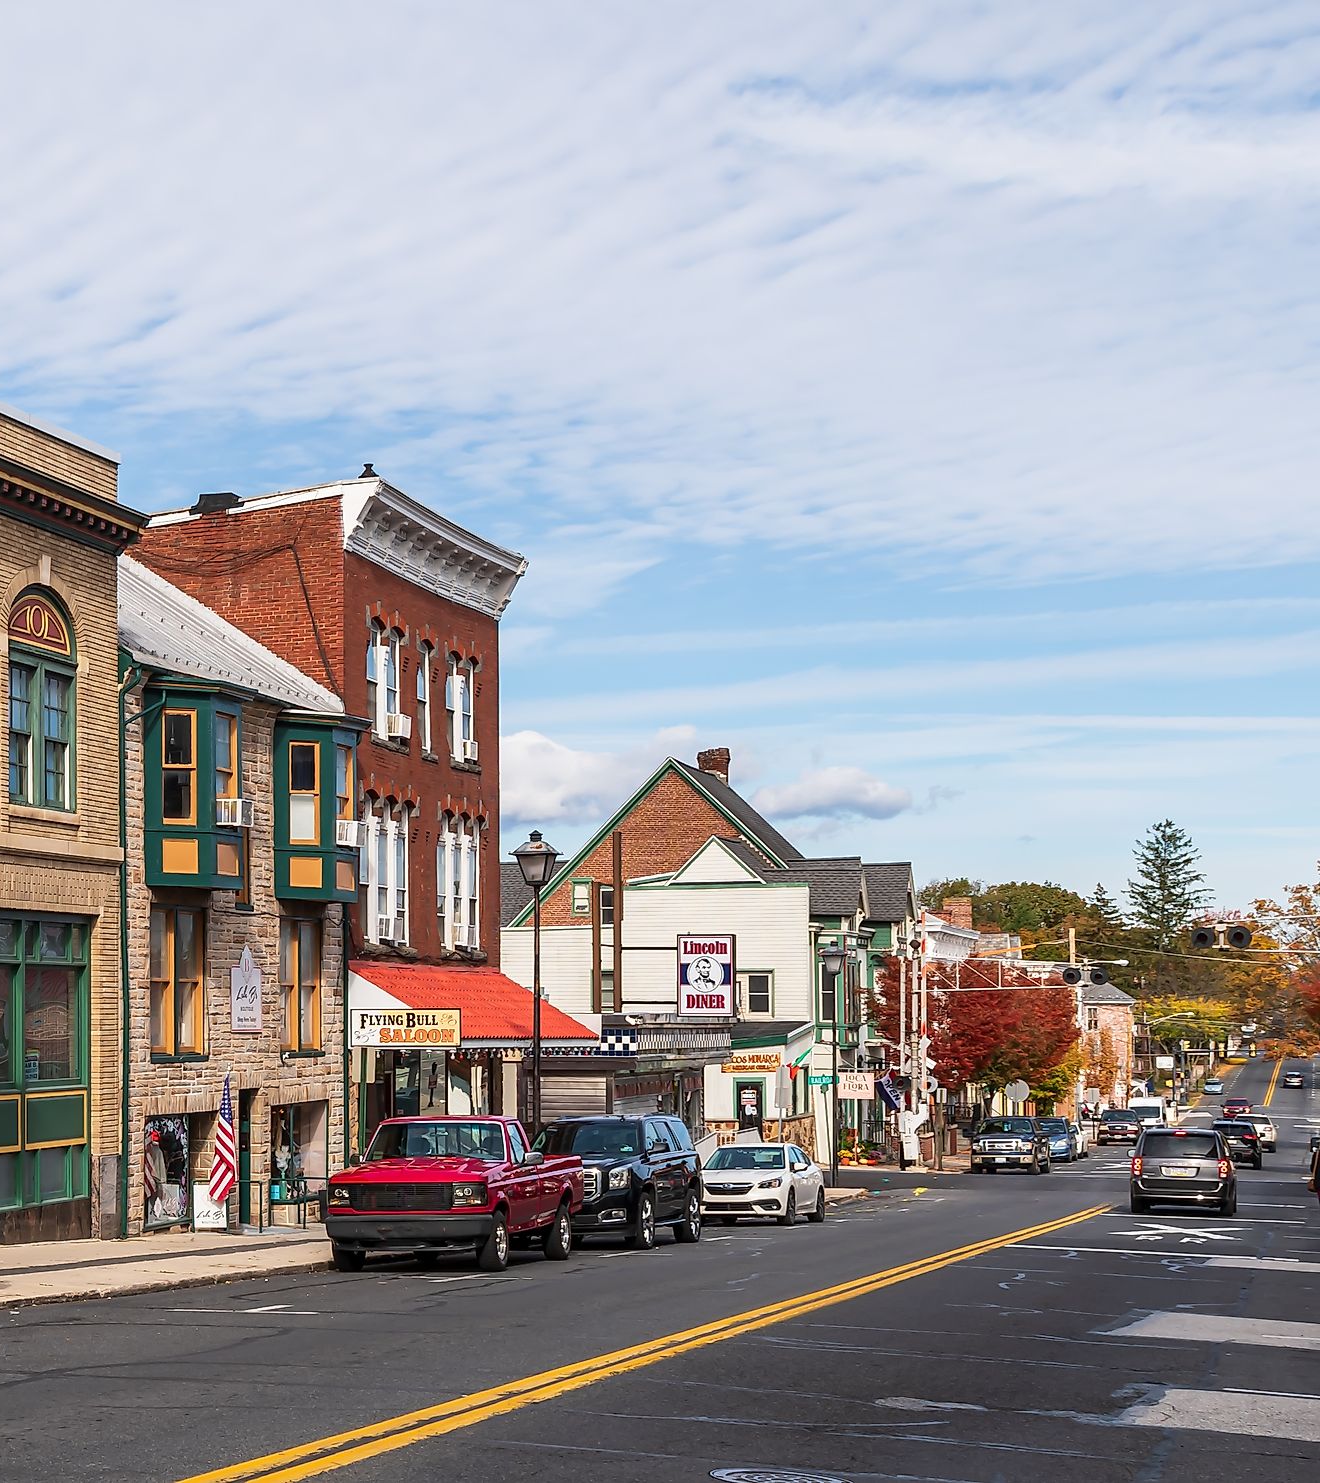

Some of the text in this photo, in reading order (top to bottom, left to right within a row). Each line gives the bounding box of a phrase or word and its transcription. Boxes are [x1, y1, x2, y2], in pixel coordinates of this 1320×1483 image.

[683, 941, 728, 954] Lincoln
[686, 994, 725, 1008] DINER
[379, 1028, 456, 1043] SALOON
